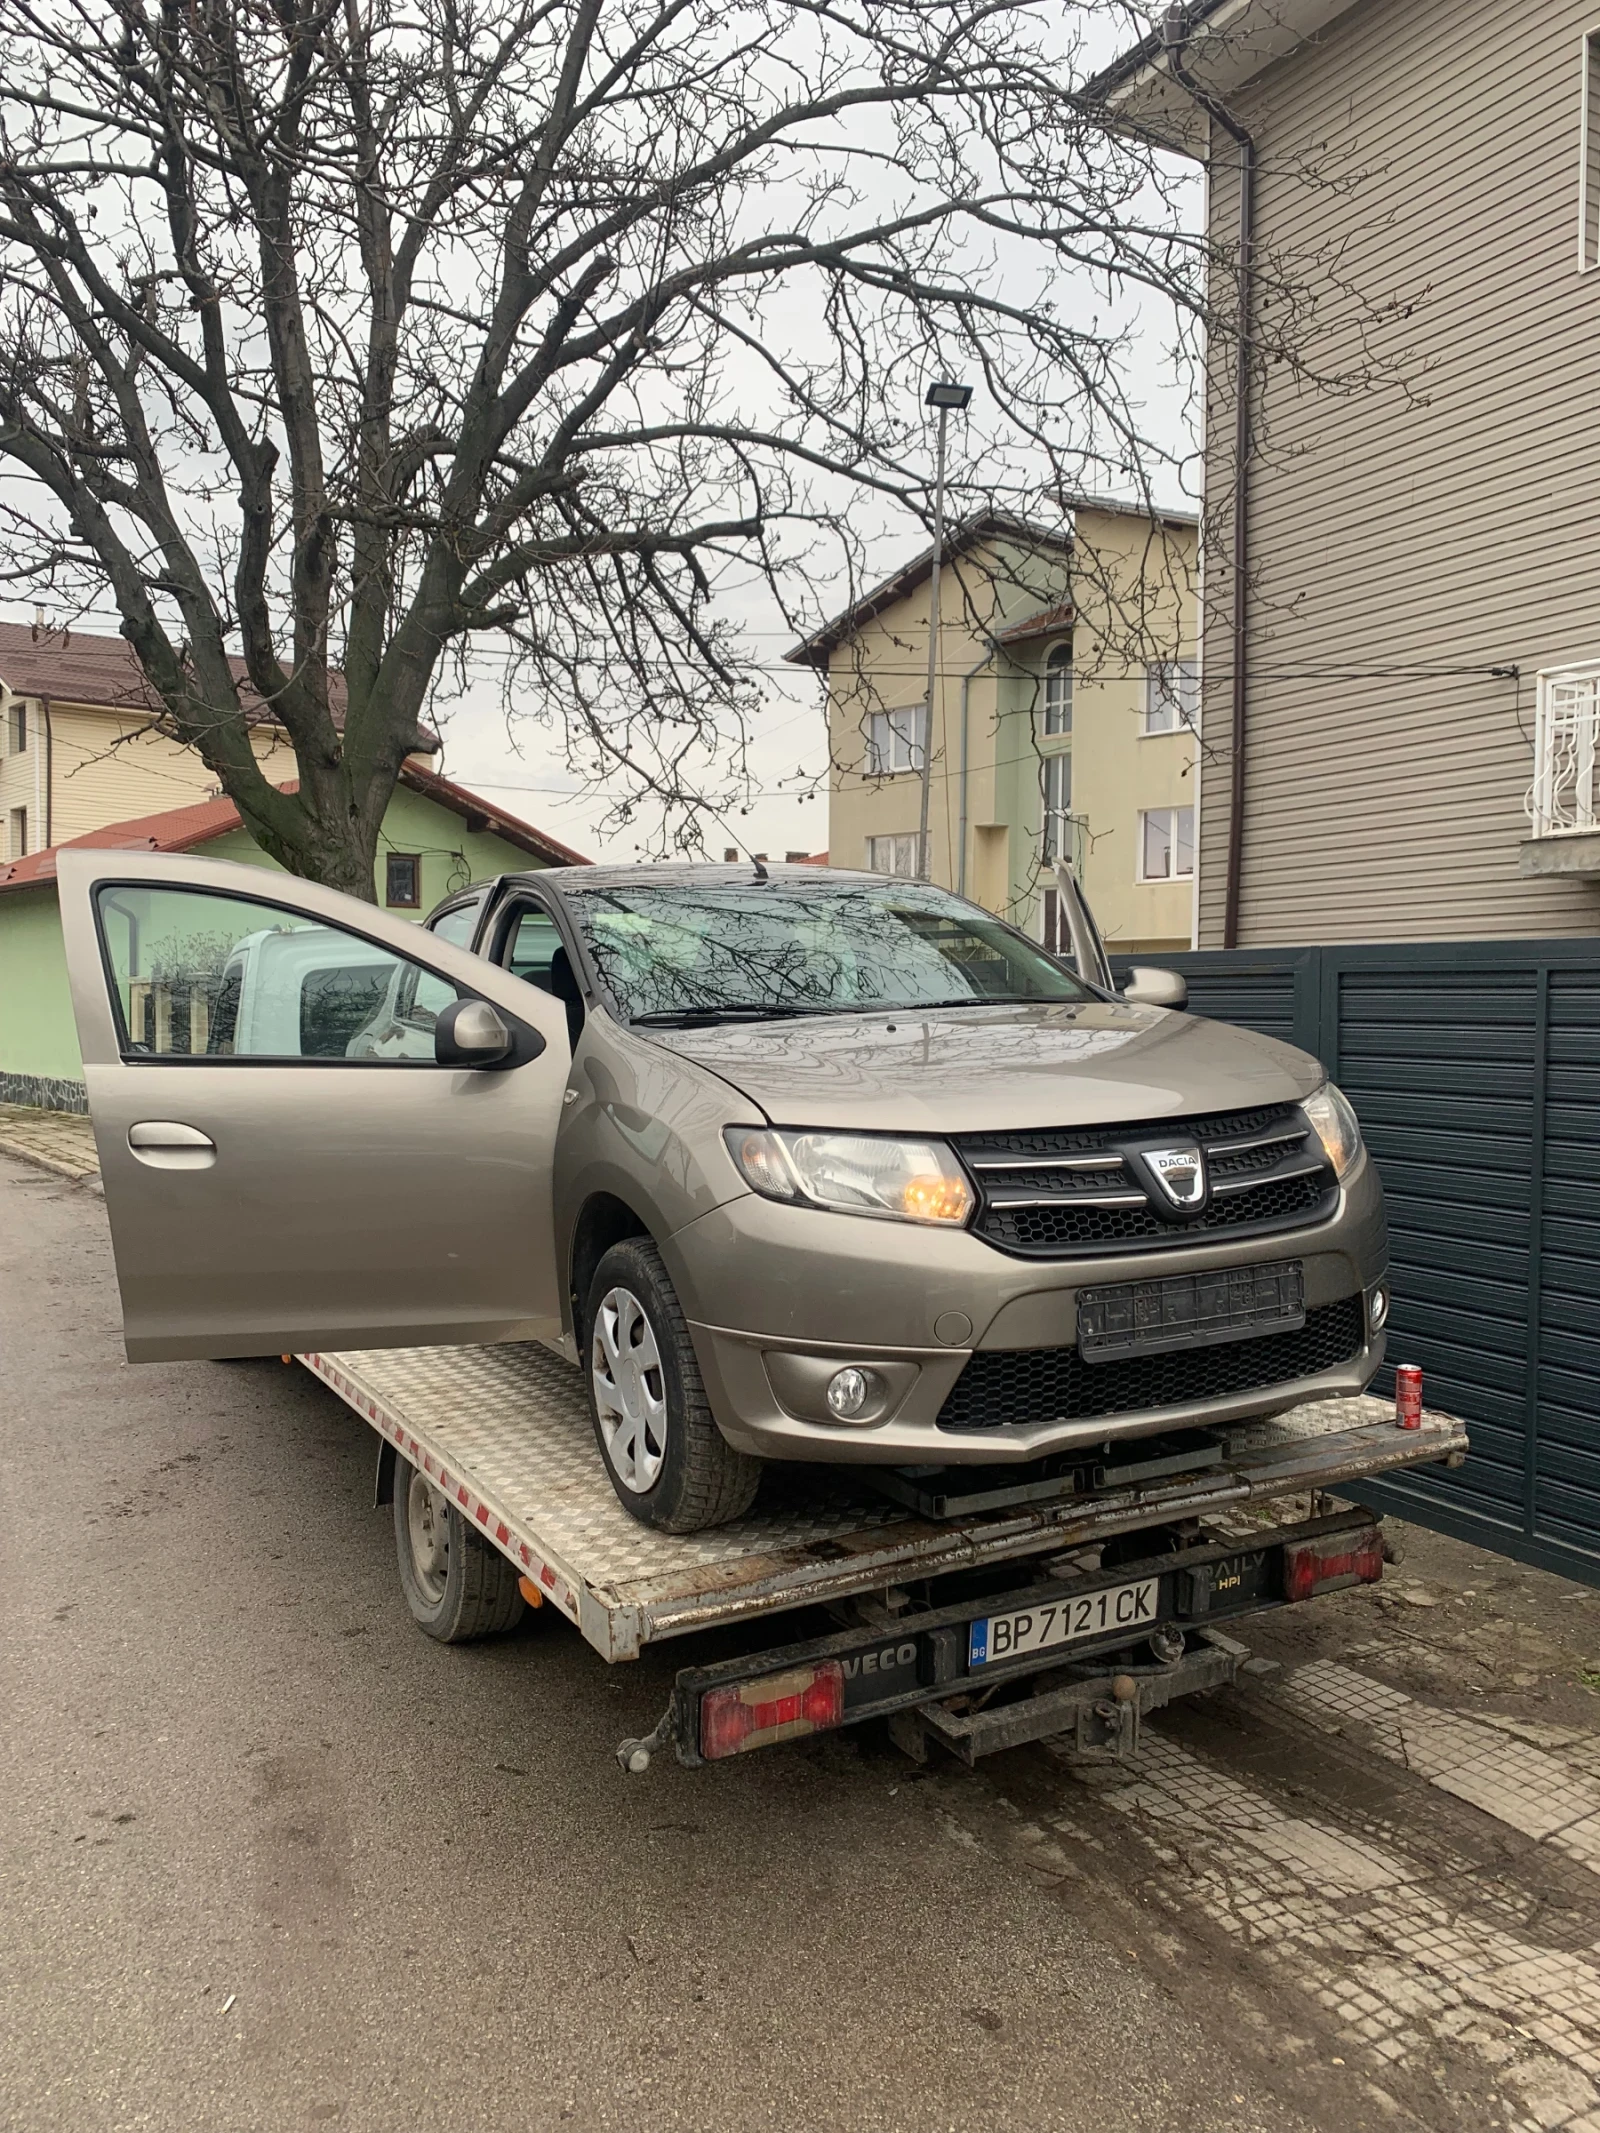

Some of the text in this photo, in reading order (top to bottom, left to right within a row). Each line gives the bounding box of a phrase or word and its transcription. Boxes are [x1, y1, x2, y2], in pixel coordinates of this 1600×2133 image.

[1158, 1156, 1197, 1168] DACIA
[1218, 1575, 1241, 1590] HPI
[971, 1646, 986, 1660] BG
[841, 1643, 918, 1680] VECO
